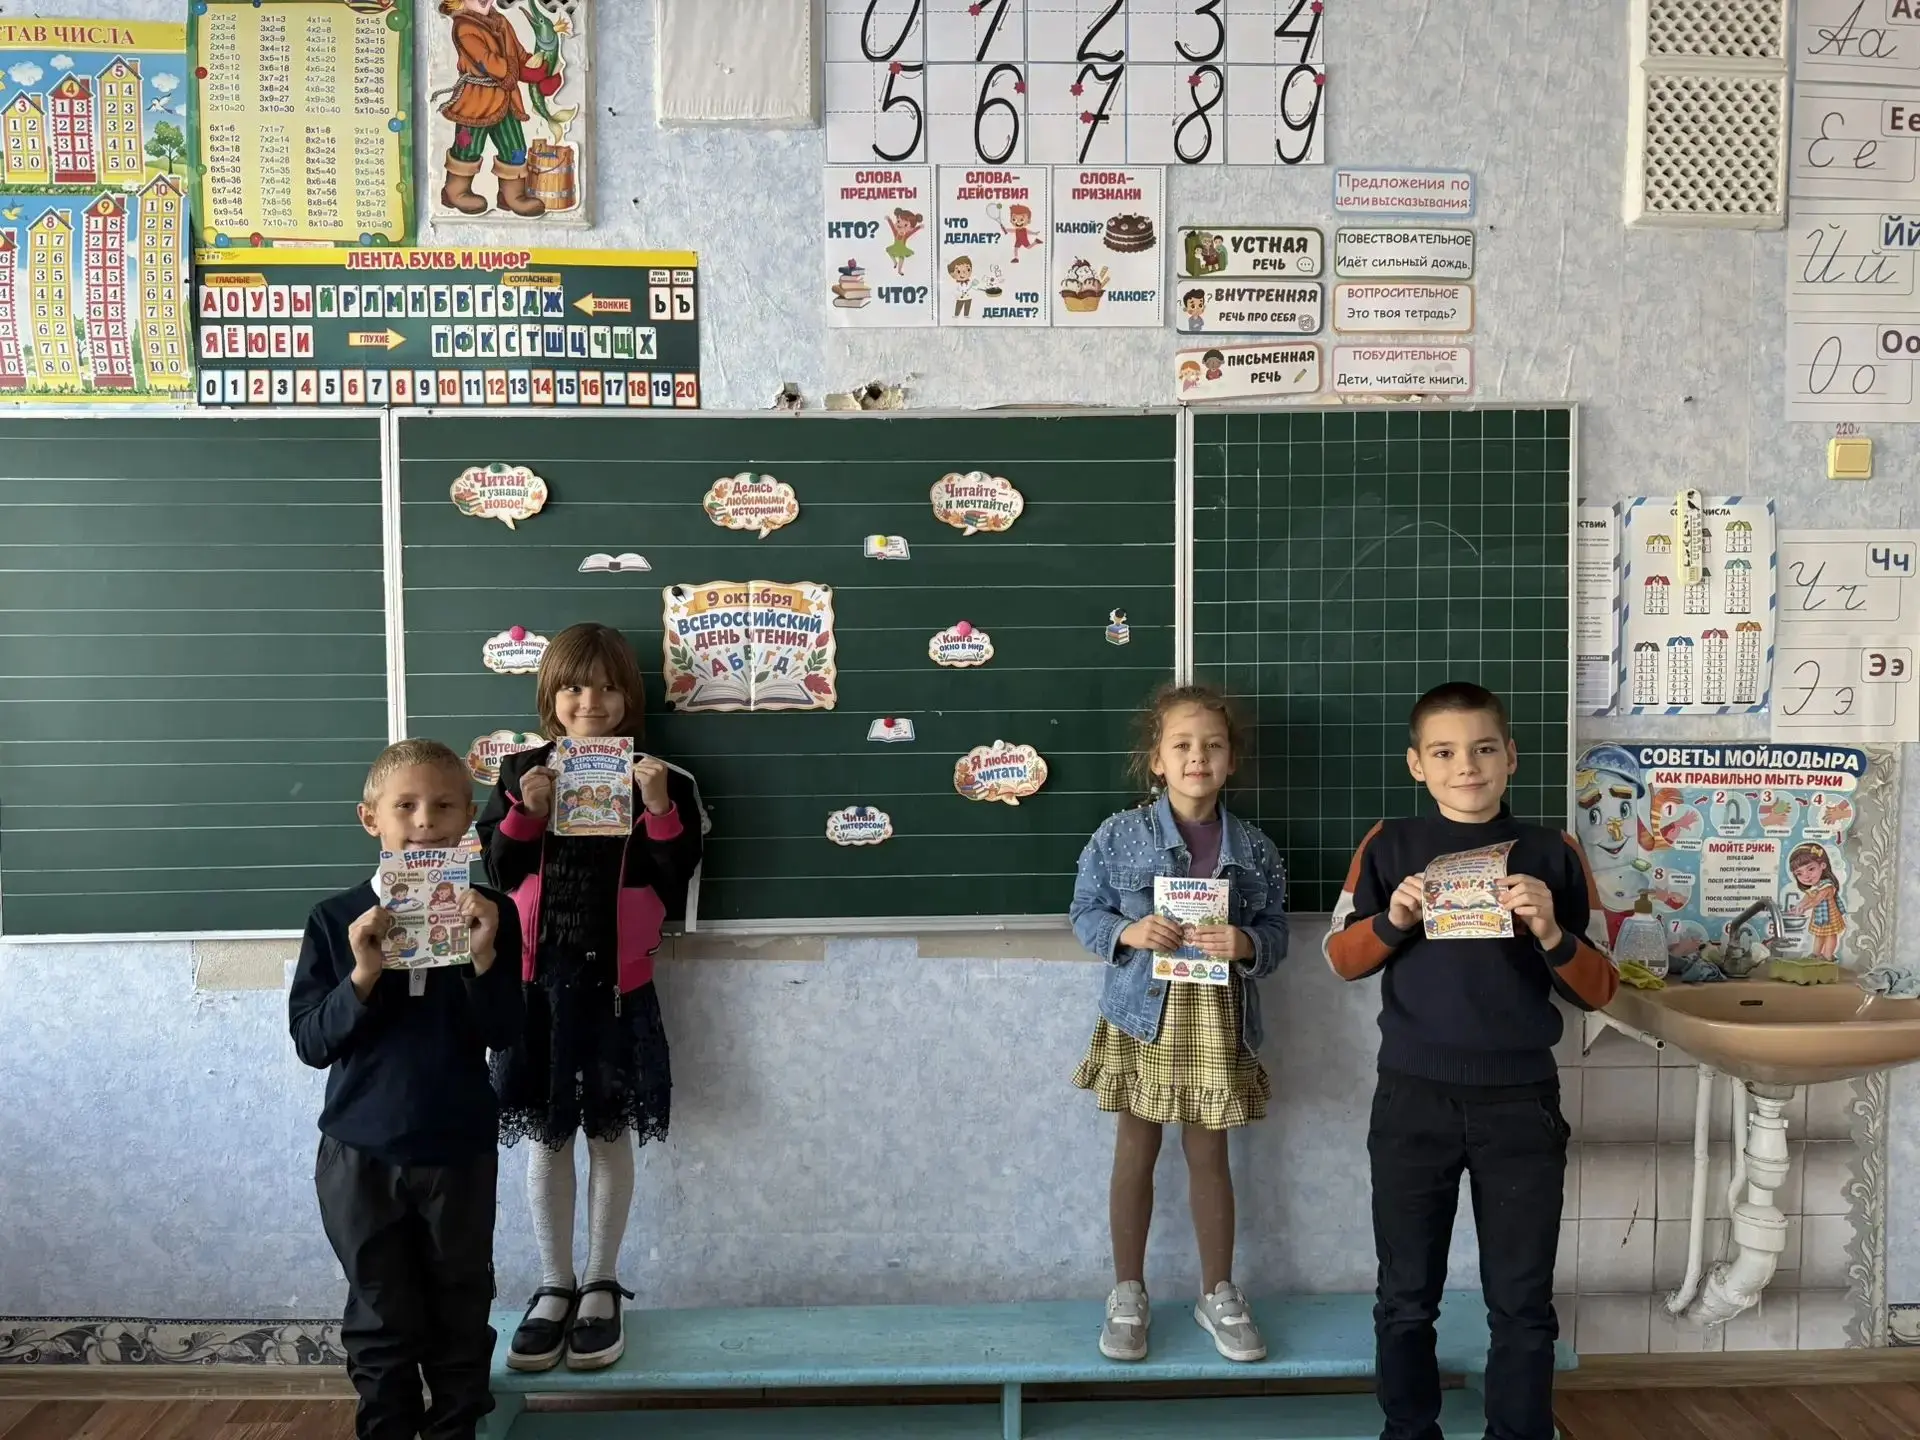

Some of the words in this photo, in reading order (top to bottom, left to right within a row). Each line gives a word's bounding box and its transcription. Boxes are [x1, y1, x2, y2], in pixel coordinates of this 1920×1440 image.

[0, 25, 47, 41] ТАВ
[54, 26, 134, 45] ЧИСЛА
[873, 63, 925, 162] 5
[974, 63, 1025, 164] 6
[1069, 63, 1124, 163] 7
[1174, 64, 1224, 164] 8
[1276, 64, 1324, 163] 9
[855, 171, 902, 184] СЛОВА
[1338, 173, 1445, 192] Предложения
[1451, 178, 1470, 191] по
[841, 187, 917, 201] ПРЕДМЕТЫ
[957, 185, 1029, 201] ДЕЙСТВИЯ
[1072, 188, 1141, 201] ПРИЗНАКИ
[1336, 196, 1370, 208] цели
[828, 221, 880, 239] КТО?
[944, 217, 969, 230] ЧТО
[1055, 219, 1104, 235] КАКОЙ?
[944, 232, 1001, 245] ДЕЛАЕТ?
[1231, 236, 1309, 253] УСТНАЯ
[1338, 233, 1472, 247] ПОВЕСТВОВАТЕЛЬНОЕ
[347, 251, 404, 268] ЛЕНТА
[409, 251, 456, 268] БУКВ
[462, 252, 473, 267] И
[478, 252, 531, 270] ЦИФР
[1252, 258, 1286, 271] РЕЧЬ
[1337, 256, 1367, 269] Идёт
[1372, 256, 1428, 268] сильный
[1431, 258, 1471, 271] дождь.
[215, 276, 250, 284] ГЛАСНЫЕ
[509, 275, 554, 284] СОГЛАСНЫЕ
[877, 286, 928, 304] ЧТО?
[1015, 291, 1039, 304] ЧТО
[1108, 290, 1156, 303] КАКОЕ?
[1215, 288, 1318, 303] ВНУТРЕННЯЯ
[1348, 287, 1459, 299] ВОПРОСИТЕЛЬНОЕ
[203, 292, 217, 311] А
[227, 292, 239, 311] О
[251, 292, 264, 311] У
[273, 292, 284, 311] Э
[293, 292, 311, 311] Ы
[593, 300, 629, 310] ЗВОНКИЕ
[982, 306, 1039, 319] ДЕЛАЕТ?
[1219, 311, 1246, 322] РЕЧЬ
[1247, 311, 1268, 322] ПРО
[1270, 311, 1296, 322] СЕБЯ
[1347, 308, 1370, 319] Это
[1374, 309, 1400, 318] твоя
[1405, 308, 1457, 321] тетрадь?
[360, 334, 390, 344] ГЛУХИЕ
[1227, 350, 1315, 367] ПИСЬМЕННАЯ
[1353, 350, 1457, 361] ПОБУДИТЕЛЬНОЕ
[1250, 371, 1282, 384] РЕЧЬ
[1337, 373, 1373, 387] Дети,
[1376, 374, 1426, 385] читайте
[1430, 375, 1468, 386] книги.
[473, 471, 526, 487] Читай
[480, 489, 486, 498] и
[487, 488, 529, 499] узнавай
[733, 481, 773, 495] Делись
[945, 483, 997, 498] Читайте
[484, 497, 524, 510] новое!
[725, 494, 786, 506] любимыми
[945, 500, 952, 509] и
[956, 498, 1013, 513] мечтайте!
[731, 505, 785, 517] историями
[1703, 508, 1731, 516] ЧИСЛА
[1872, 548, 1909, 571] Чч
[706, 591, 719, 606] 9
[723, 588, 793, 607] октября
[677, 609, 822, 636] ВСЕРОССИЙСКИЙ
[694, 629, 740, 650] ДЕНЬ
[744, 629, 808, 648] ЧТЕНИЯ
[942, 634, 973, 644] Книга
[488, 641, 513, 651] Открой
[497, 648, 524, 657] открой
[526, 649, 541, 657] мир
[939, 643, 959, 652] окно
[968, 643, 984, 652] мир
[728, 653, 744, 671] Б
[1869, 653, 1904, 677] Ээ
[569, 748, 577, 757] 9
[580, 744, 622, 756] ОКТЯБРЯ
[485, 756, 497, 766] по
[970, 756, 982, 771] Я
[984, 752, 1025, 767] люблю
[1639, 748, 1720, 767] СОВЕТЫ
[1724, 745, 1859, 771] МОЙДОДЫРА
[574, 763, 592, 771] ДЕНЬ
[978, 765, 1028, 782] читать!
[1655, 772, 1682, 784] КАК
[1685, 772, 1762, 785] ПРАВИЛЬНО
[1764, 774, 1804, 786] МЫТЬ
[1806, 775, 1843, 787] РУКИ
[1716, 791, 1725, 803] 2
[1763, 791, 1772, 802] 3
[1814, 794, 1823, 805] 4
[1665, 804, 1673, 816] 1
[842, 812, 876, 823] Читай
[840, 822, 886, 831] интересом!
[1709, 841, 1744, 853] МОЙТЕ
[1746, 843, 1775, 853] РУКИ:
[404, 850, 447, 860] БЕРЕГИ
[406, 860, 445, 869] КНИГУ
[1654, 868, 1664, 879] 8
[1170, 881, 1207, 891] КНИГА
[1443, 880, 1485, 891] КНИГА
[1164, 890, 1191, 900] ТВОЙ
[1193, 892, 1218, 902] ДРУГ
[1451, 913, 1484, 921] Читайте
